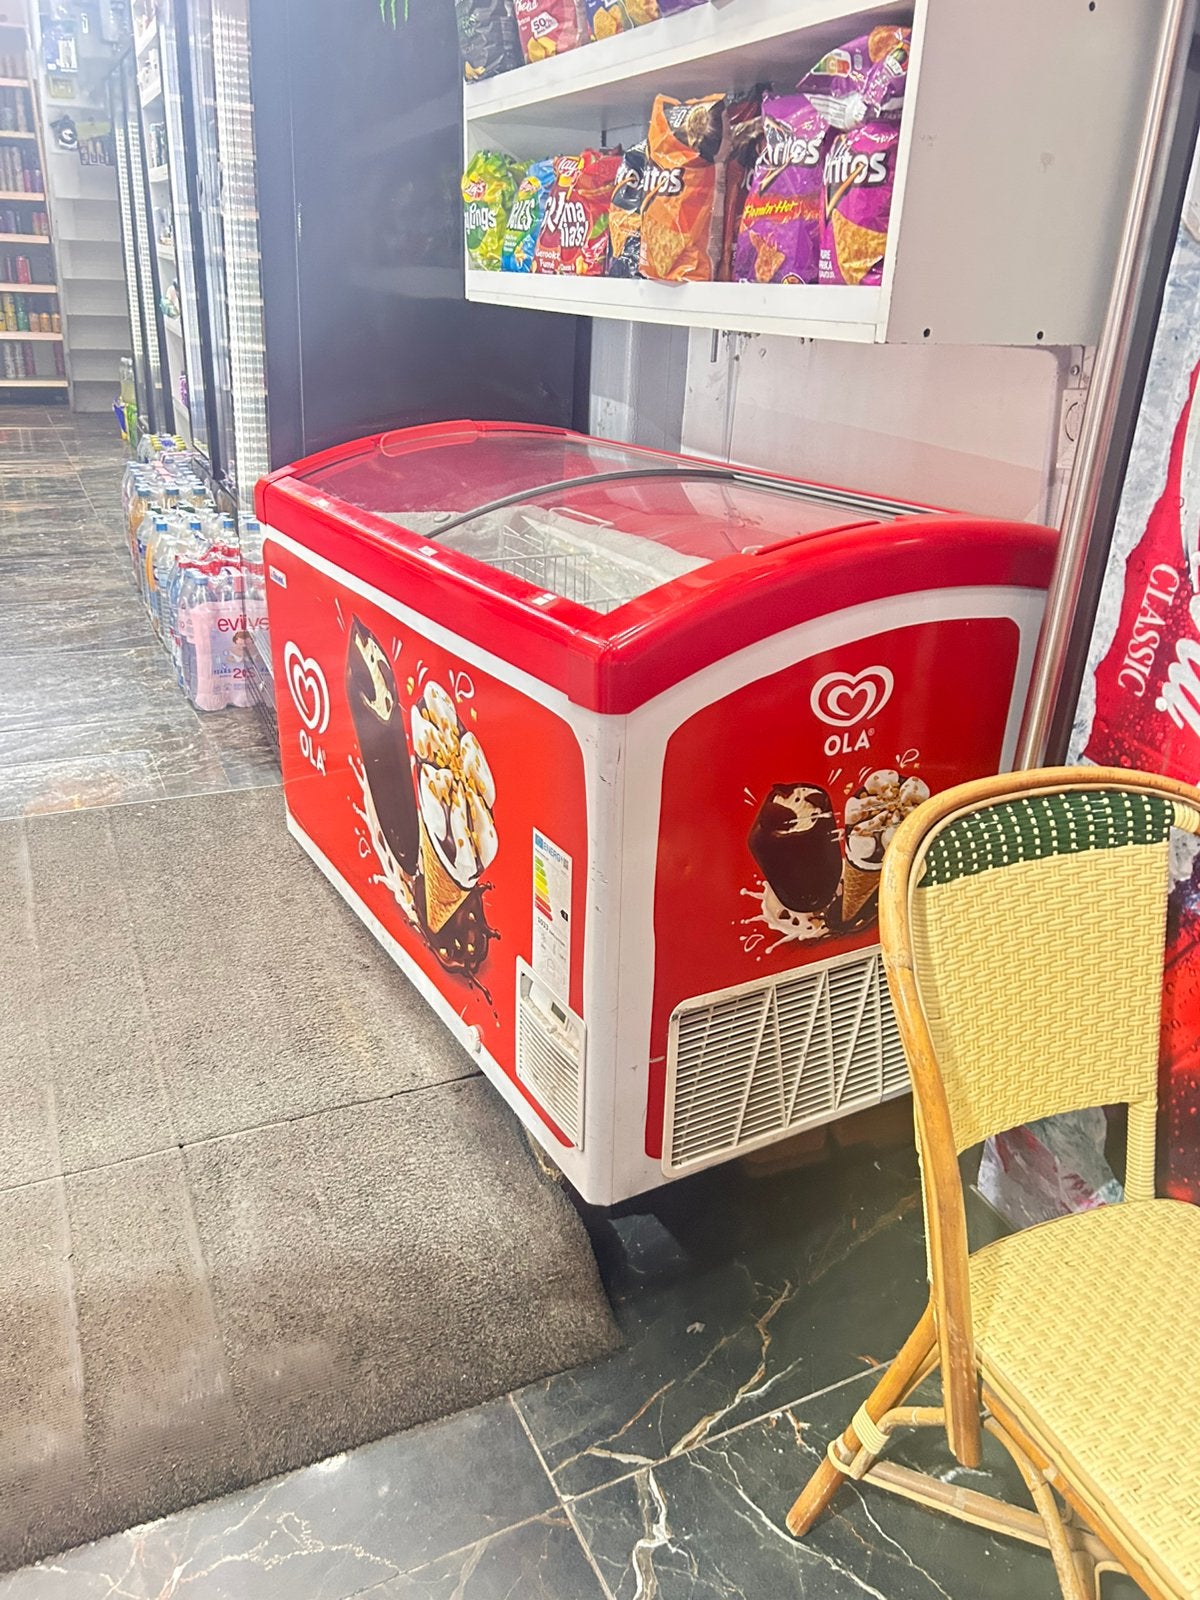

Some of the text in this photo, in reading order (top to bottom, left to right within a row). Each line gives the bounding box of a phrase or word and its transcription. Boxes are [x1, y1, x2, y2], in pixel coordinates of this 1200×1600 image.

[1118, 563, 1180, 698] CLASSIC
[300, 729, 326, 777] OLA
[824, 729, 871, 757] OLA
